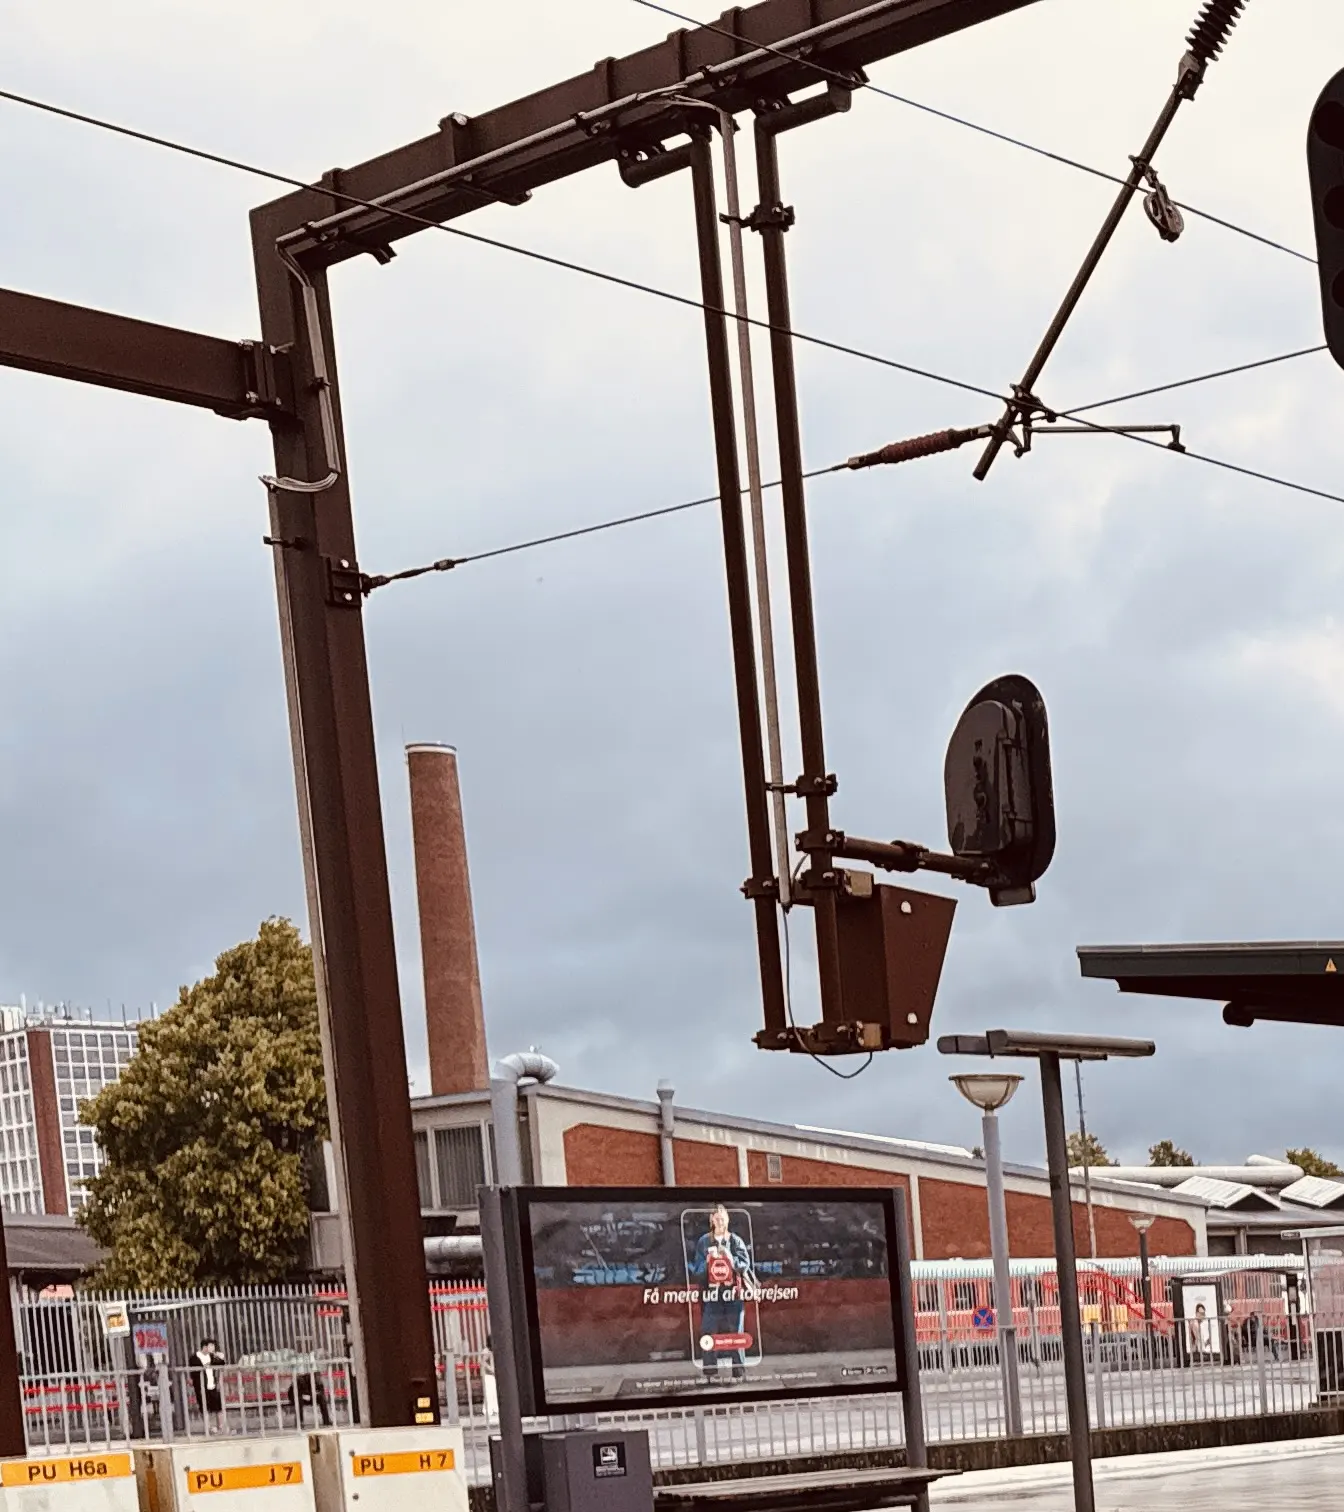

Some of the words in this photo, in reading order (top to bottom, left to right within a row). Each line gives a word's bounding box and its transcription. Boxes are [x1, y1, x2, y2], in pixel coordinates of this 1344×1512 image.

[643, 1286, 660, 1304] Få
[664, 1289, 699, 1304] mere
[702, 1285, 719, 1301] ud
[722, 1285, 738, 1301] af
[28, 1464, 57, 1481] PU
[69, 1460, 108, 1477] H6a
[361, 1457, 385, 1475] PU
[196, 1472, 223, 1489] PU
